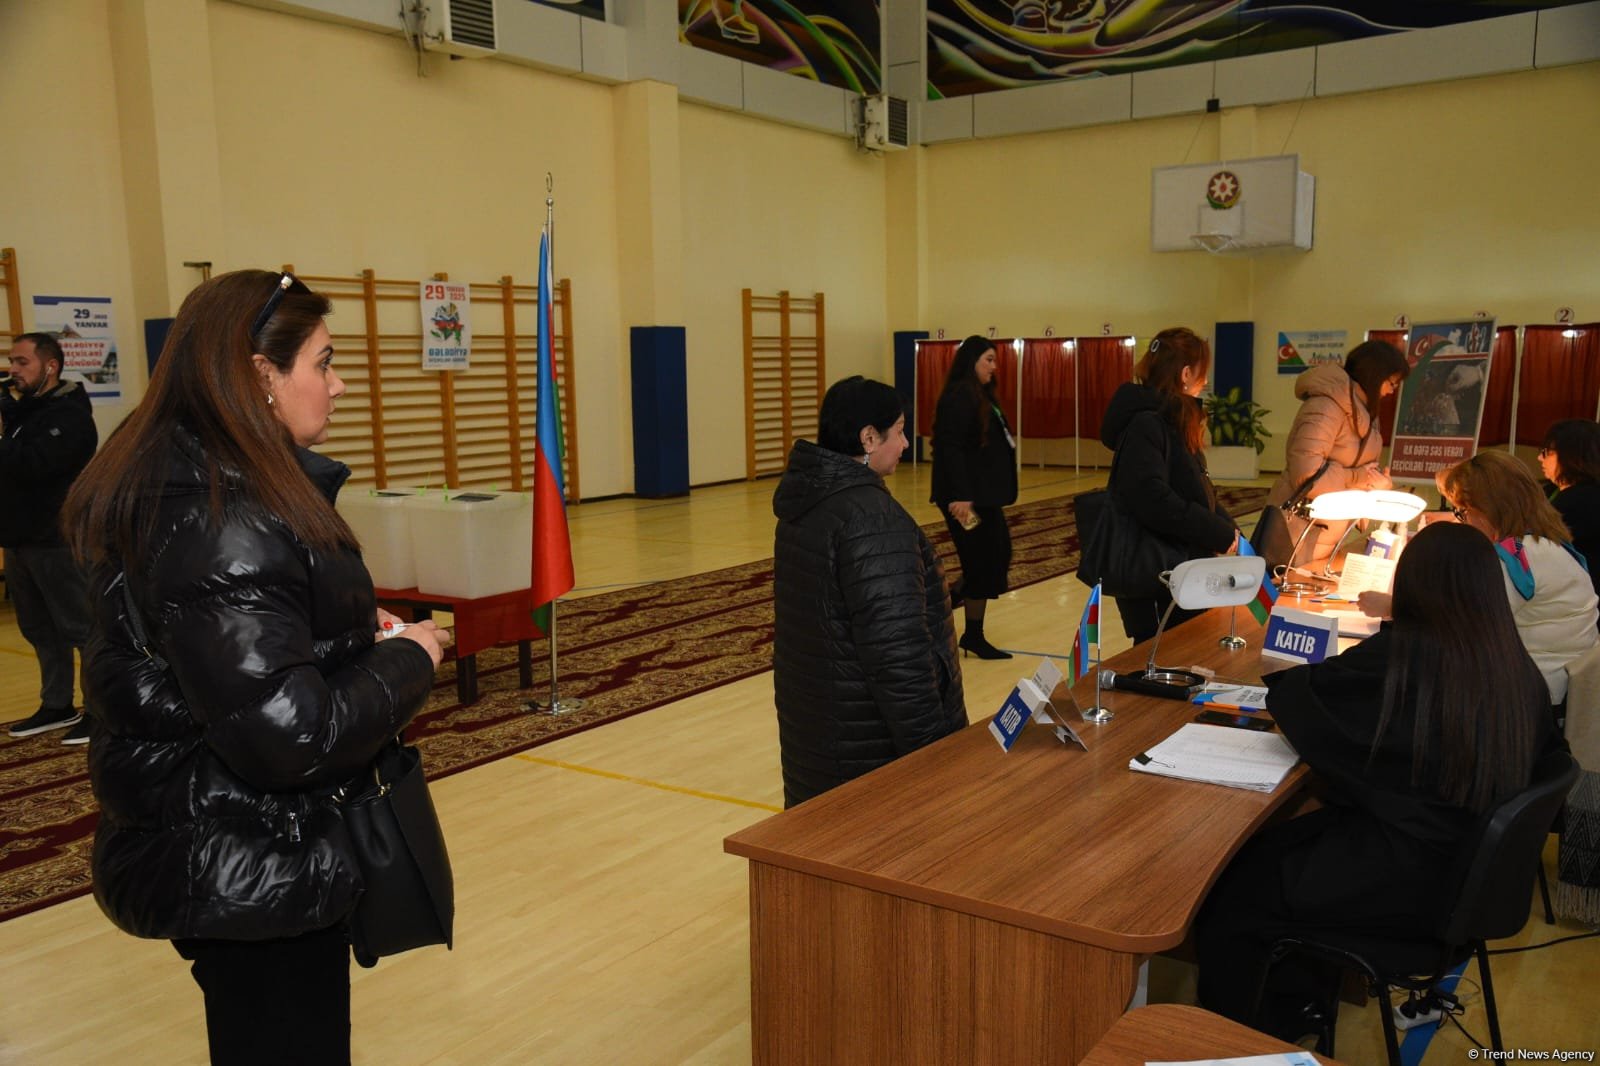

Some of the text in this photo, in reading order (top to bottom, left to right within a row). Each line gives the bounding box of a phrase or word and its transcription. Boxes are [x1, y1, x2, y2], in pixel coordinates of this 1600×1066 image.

[427, 285, 445, 300] 29
[73, 308, 90, 319] 29
[1558, 309, 1569, 323] 2
[75, 321, 108, 329] YANVAR
[1395, 315, 1407, 328] 4
[937, 329, 945, 340] 8
[987, 327, 996, 338] 7
[1044, 327, 1053, 338] 6
[1102, 324, 1111, 336] 5
[1274, 629, 1317, 655] KATİB
[1000, 703, 1022, 736] KATİB
